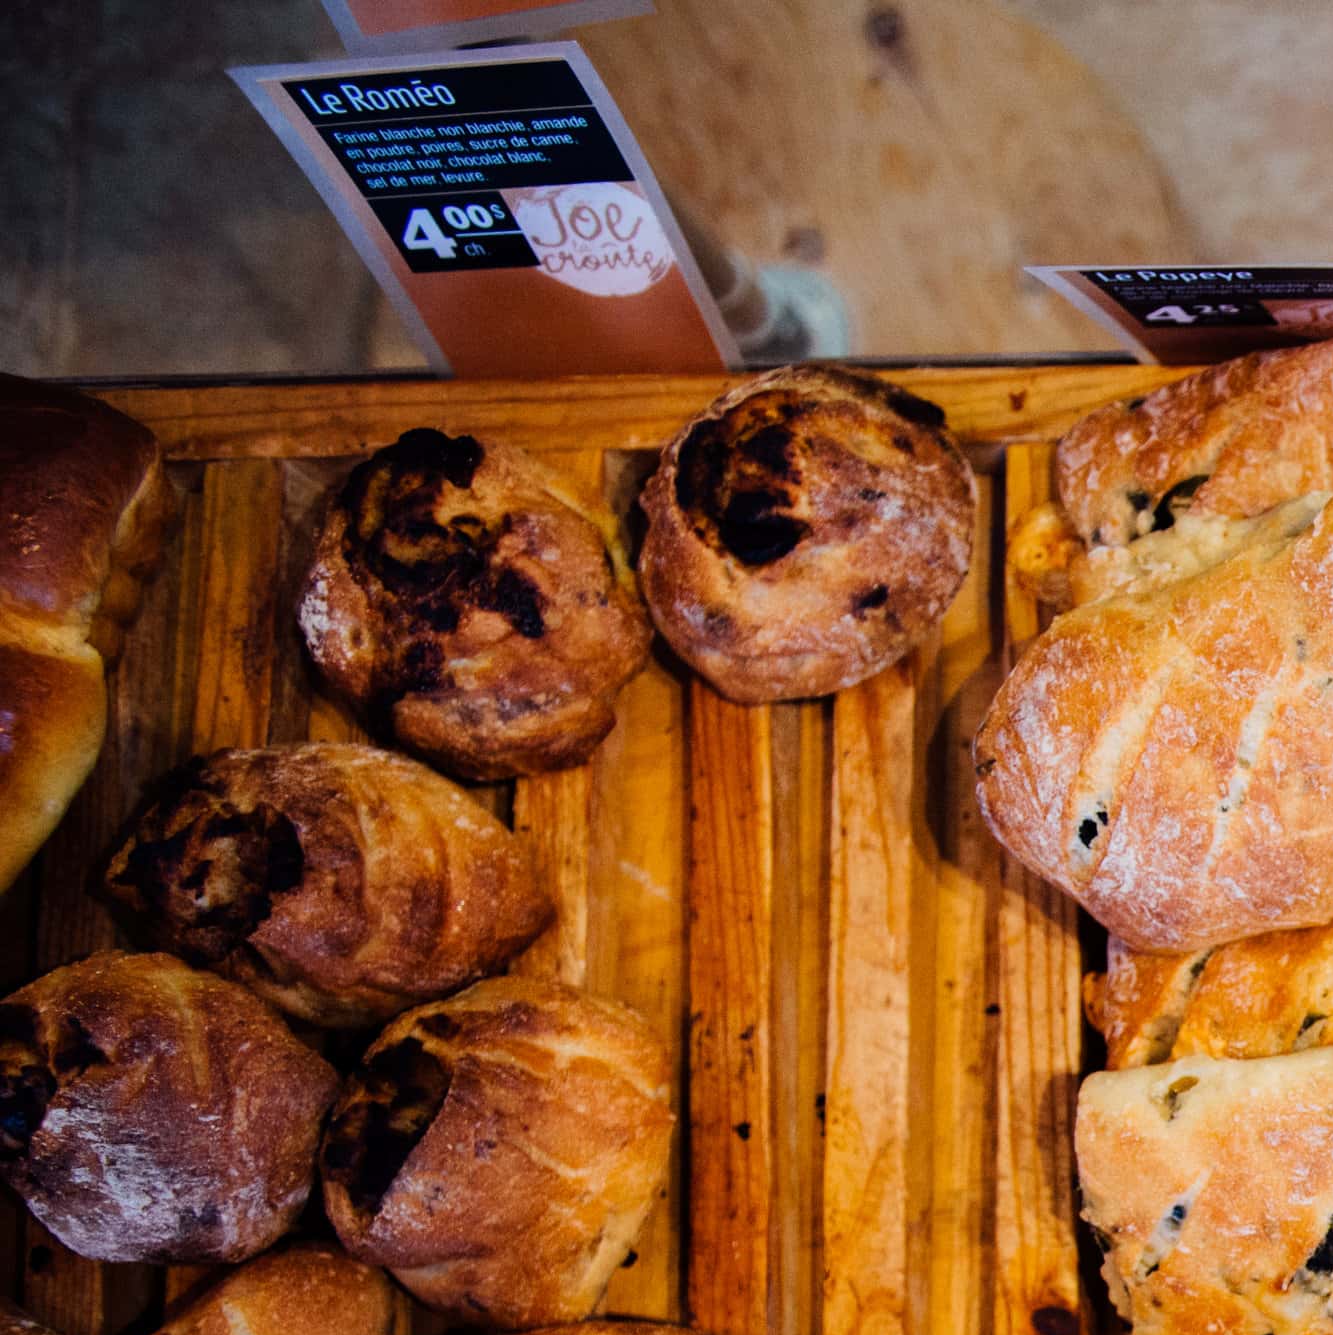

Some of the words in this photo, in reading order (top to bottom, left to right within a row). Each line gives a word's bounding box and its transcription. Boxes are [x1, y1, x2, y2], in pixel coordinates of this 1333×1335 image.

[302, 87, 347, 116] Le
[334, 130, 381, 146] Farine
[381, 125, 437, 143] blanche
[437, 123, 466, 138] non
[531, 115, 589, 132] amande
[345, 147, 366, 161] en
[468, 138, 509, 151] sucre
[509, 135, 531, 148] de
[356, 159, 416, 175] chocolat
[448, 153, 507, 169] chocolat
[365, 175, 389, 190] sel
[389, 173, 410, 188] de
[529, 190, 643, 248] Joe
[1095, 270, 1131, 283] Le
[1137, 269, 1254, 284] Popeye
